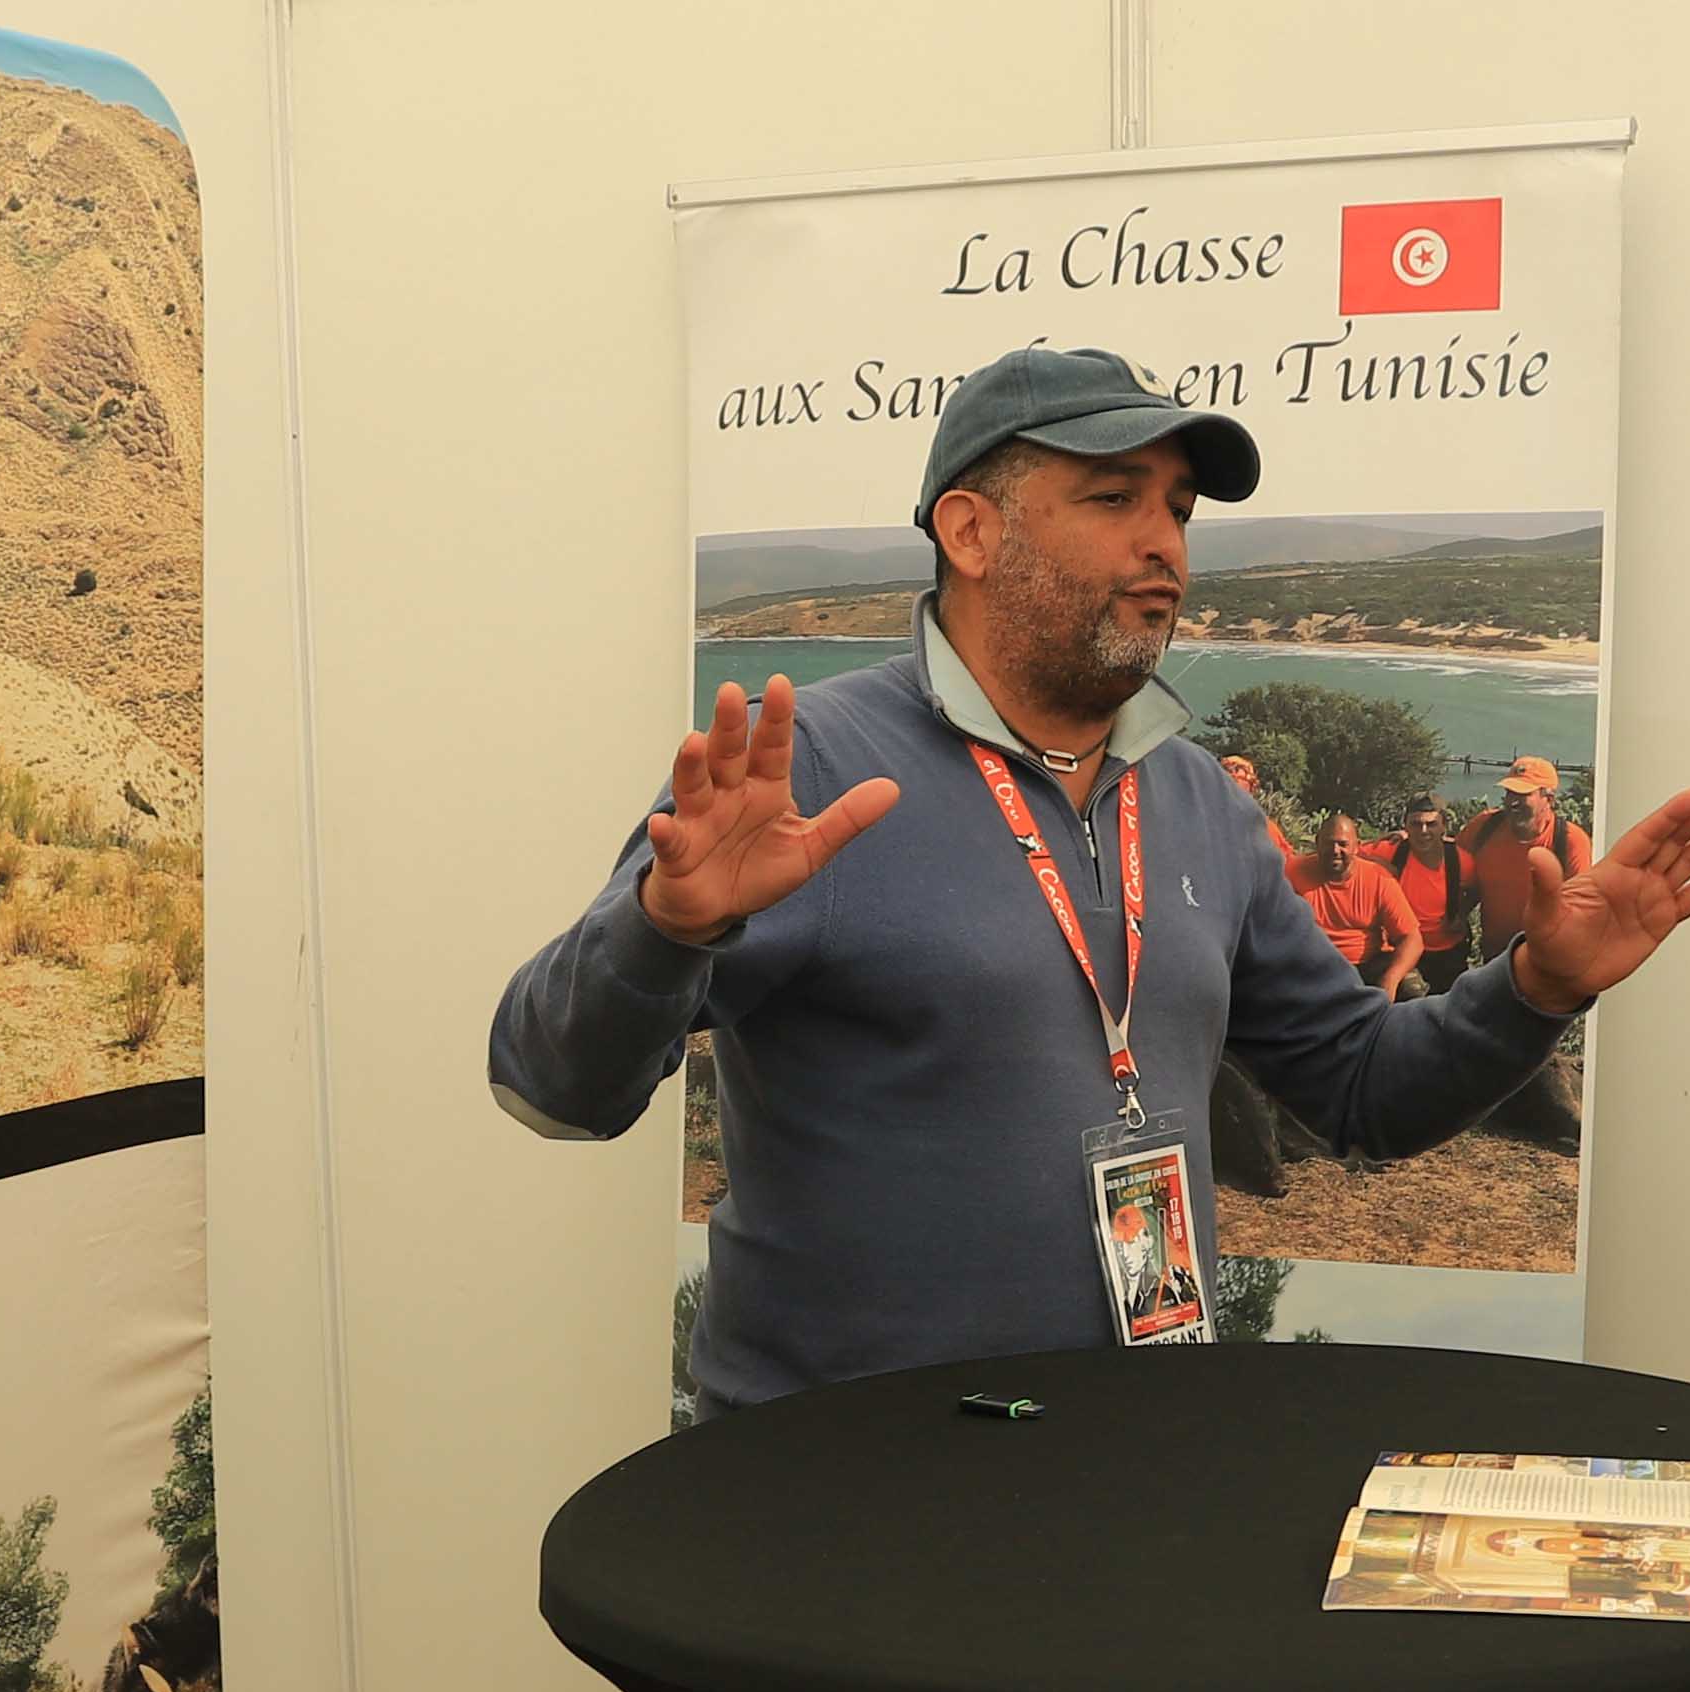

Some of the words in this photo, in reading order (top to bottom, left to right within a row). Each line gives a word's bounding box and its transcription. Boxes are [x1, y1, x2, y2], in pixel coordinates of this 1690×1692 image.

[940, 231, 1033, 296] La
[1060, 206, 1285, 292] Chasse
[716, 377, 824, 431] aux
[1174, 361, 1249, 408] en
[1275, 319, 1551, 404] Tunisie
